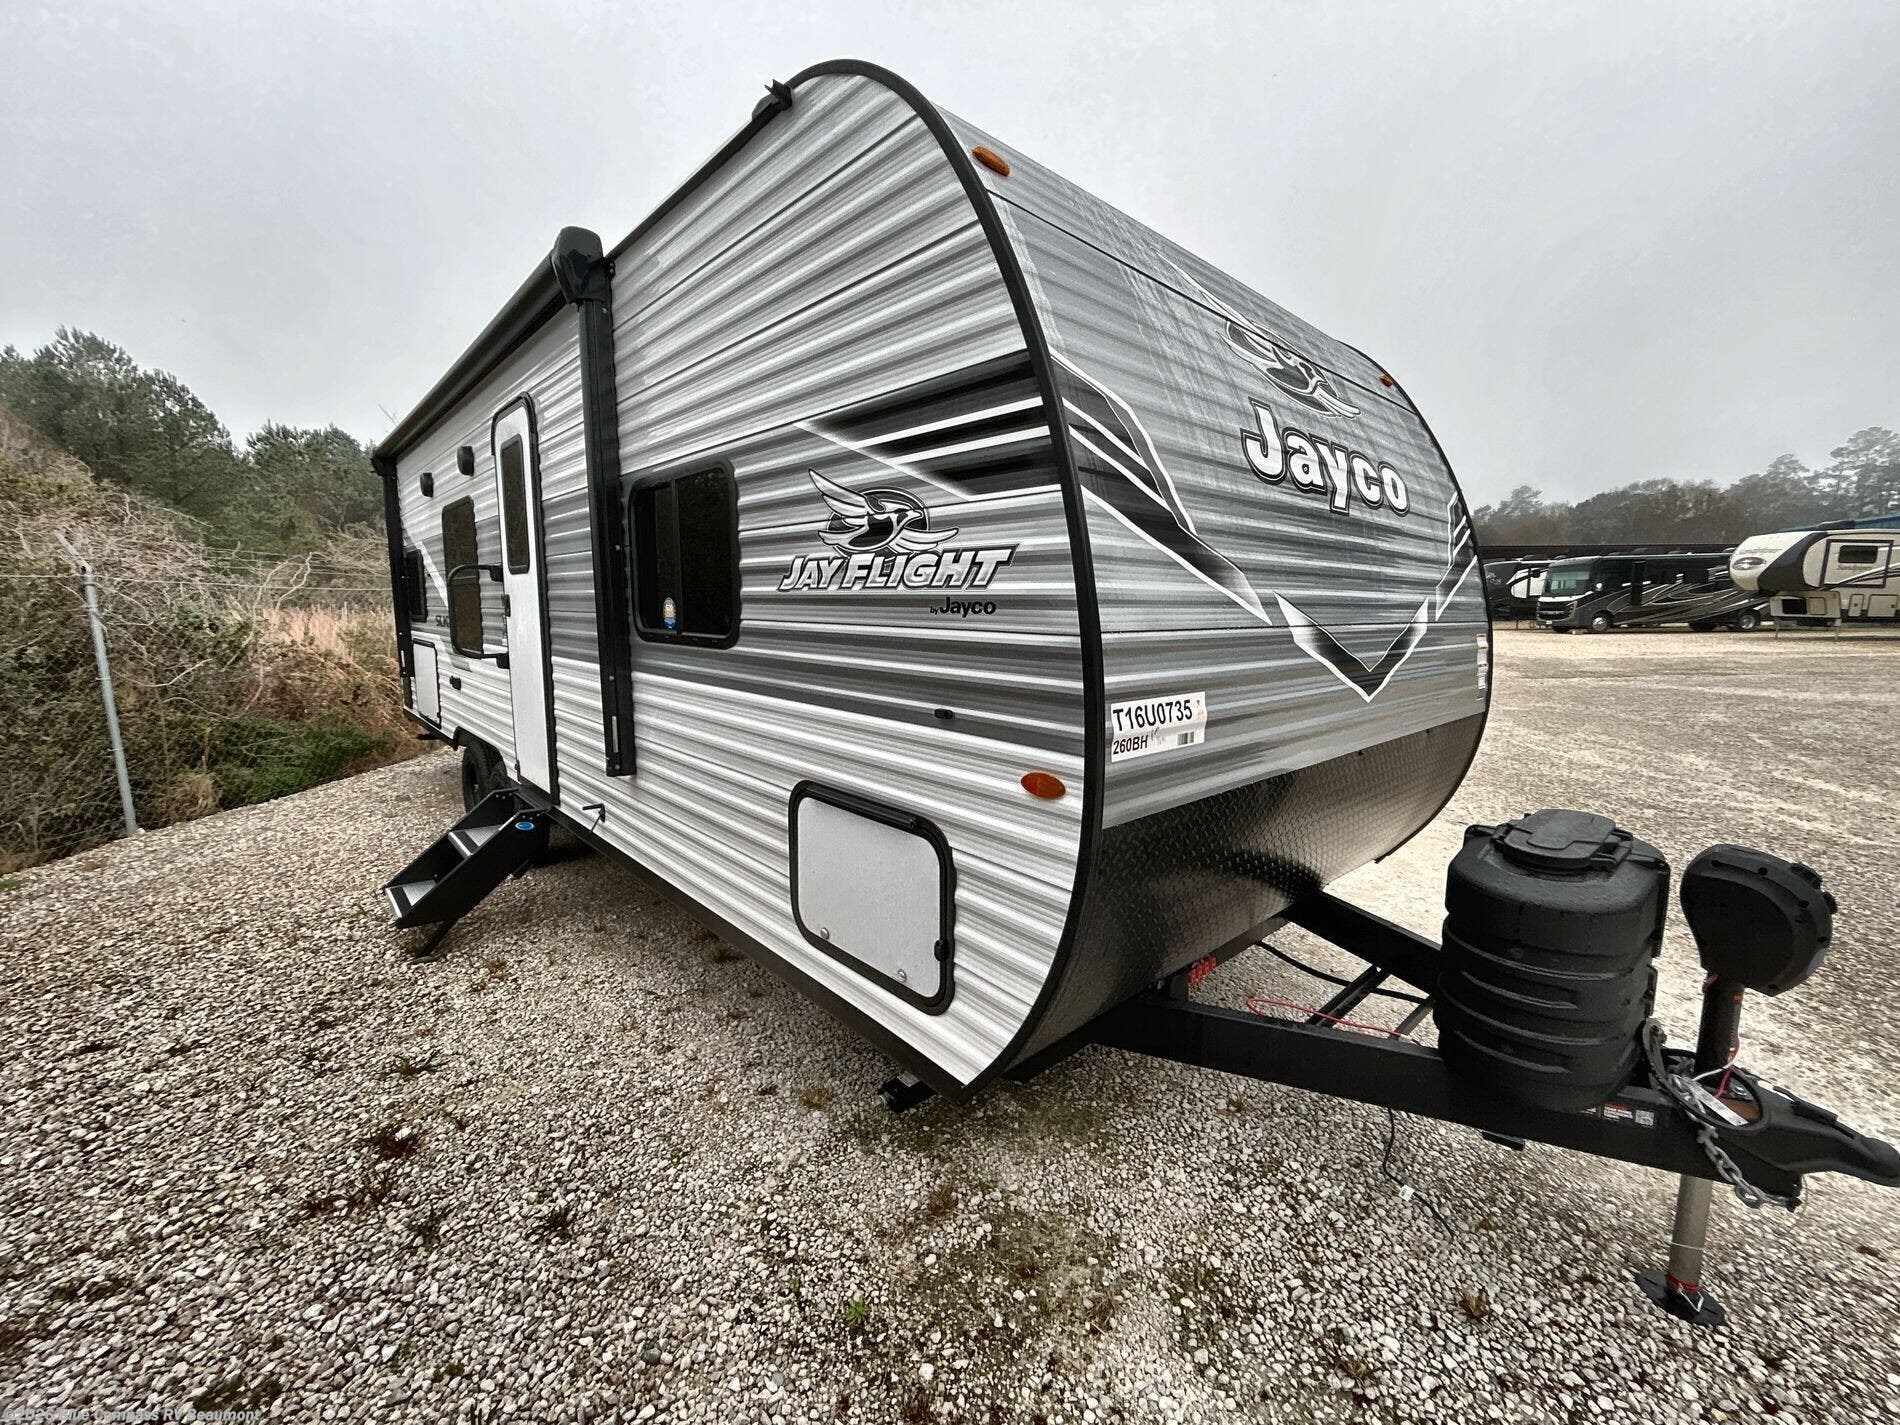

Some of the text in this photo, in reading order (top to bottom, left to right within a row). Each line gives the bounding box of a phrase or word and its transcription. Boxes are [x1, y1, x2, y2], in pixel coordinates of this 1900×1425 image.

[1240, 396, 1410, 516] Jayco
[778, 544, 1019, 592] JAY FLIGHT
[930, 597, 997, 618] by Jayco
[1112, 699, 1193, 731] T16U0735
[1112, 734, 1149, 755] 260BH
